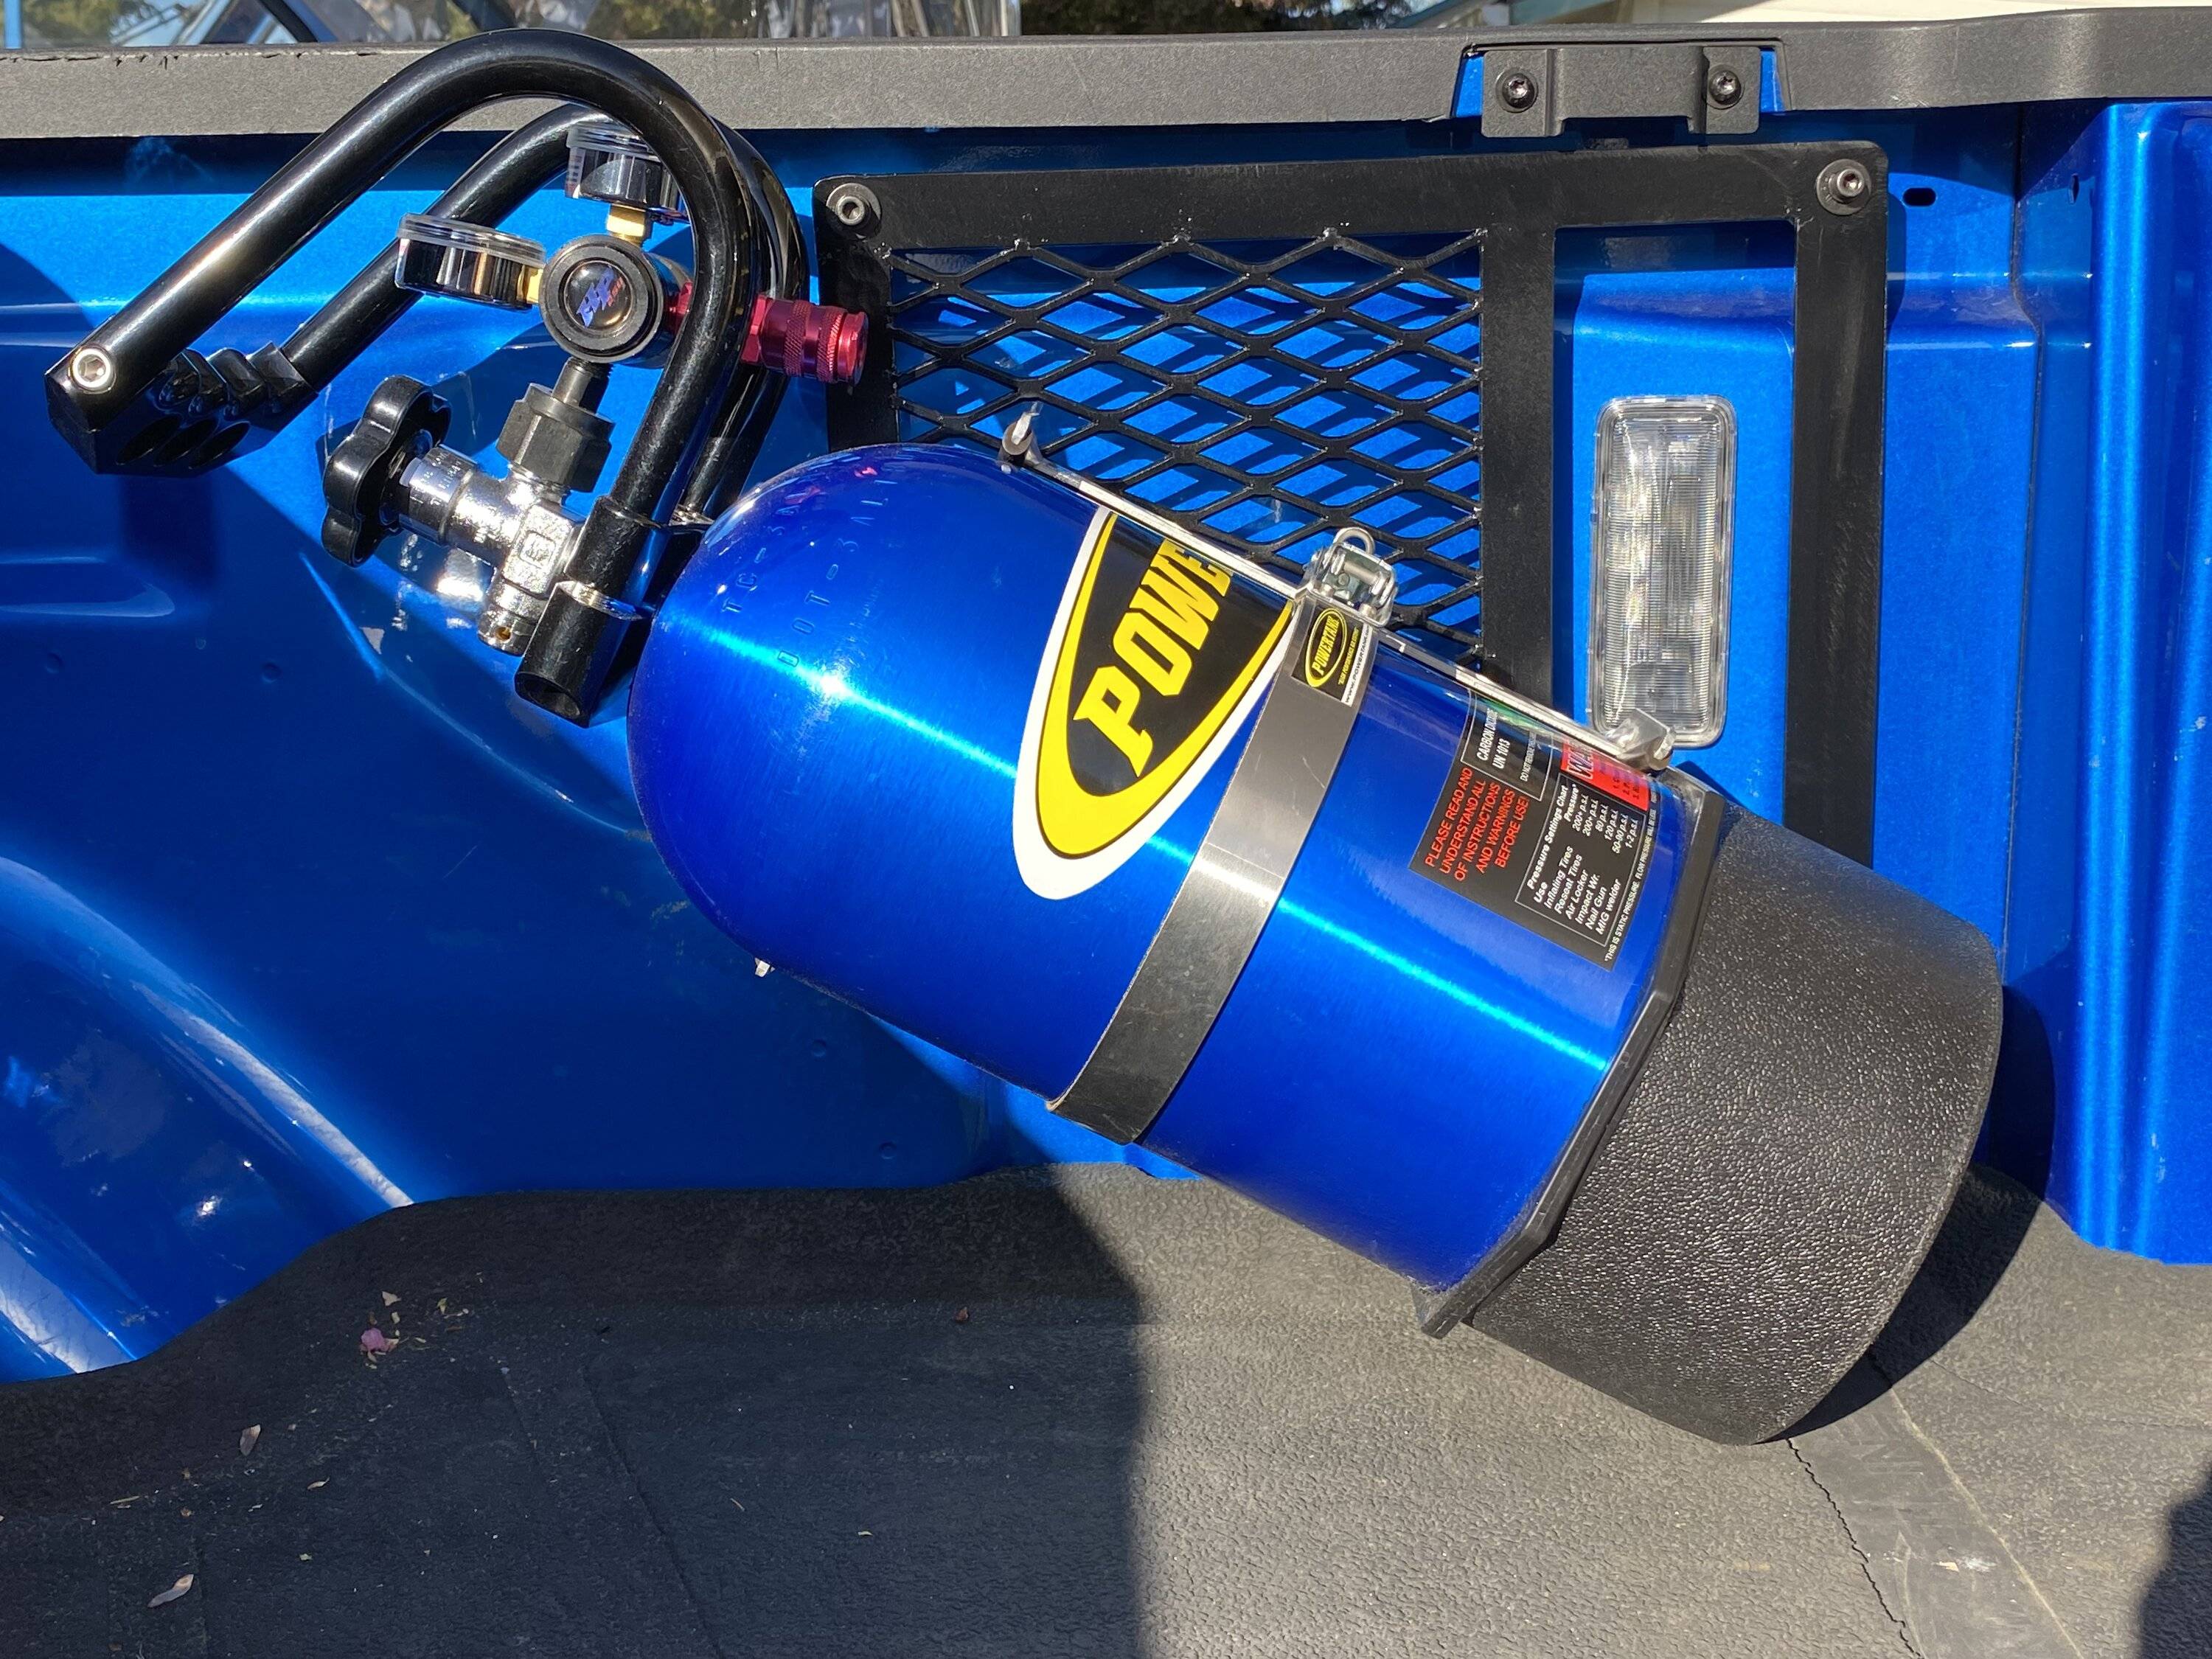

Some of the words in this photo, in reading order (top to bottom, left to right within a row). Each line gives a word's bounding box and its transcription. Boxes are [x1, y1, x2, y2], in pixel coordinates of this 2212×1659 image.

[1312, 616, 1340, 676] POWERTANK
[1477, 728, 1495, 761] CARBON
[1492, 757, 1506, 769] UN
[1497, 738, 1511, 757] 1013
[1425, 820, 1452, 866] PLEASE
[1445, 789, 1464, 819] READ
[1457, 767, 1472, 790] AND
[1440, 796, 1478, 874] UNDERSTAND
[1471, 778, 1485, 797] ALL
[1455, 862, 1468, 881] OF
[1462, 782, 1500, 861] INSTRUCTIONS
[1476, 846, 1492, 872] AND
[1486, 788, 1514, 845] WARNINGS
[1527, 843, 1550, 890] Pressure
[1544, 807, 1564, 844] Settings
[1556, 785, 1569, 807] Chart
[1495, 821, 1520, 867] BEFORE
[1543, 869, 1566, 909] Inflating
[1559, 844, 1574, 869] Tires
[1572, 810, 1585, 832] 200+
[1554, 877, 1574, 914] Reseat
[1568, 853, 1582, 877] Tires
[1582, 815, 1595, 837] 200+
[1640, 835, 1651, 863] PRESSURE
[1534, 880, 1548, 903] Use
[1564, 901, 1576, 919] Air
[1570, 869, 1589, 903] Locker
[1575, 890, 1595, 924] Impact
[1587, 872, 1600, 889] Wr.
[1604, 824, 1615, 841] 120
[1595, 910, 1610, 934] MIG
[1604, 878, 1622, 912] welder
[1624, 833, 1635, 849] 1-2
[1635, 861, 1646, 880] FLOW
[1584, 907, 1599, 929] Nail
[1593, 886, 1607, 908] Gun
[1615, 914, 1628, 937] STATIC
[1611, 936, 1619, 945] IS
